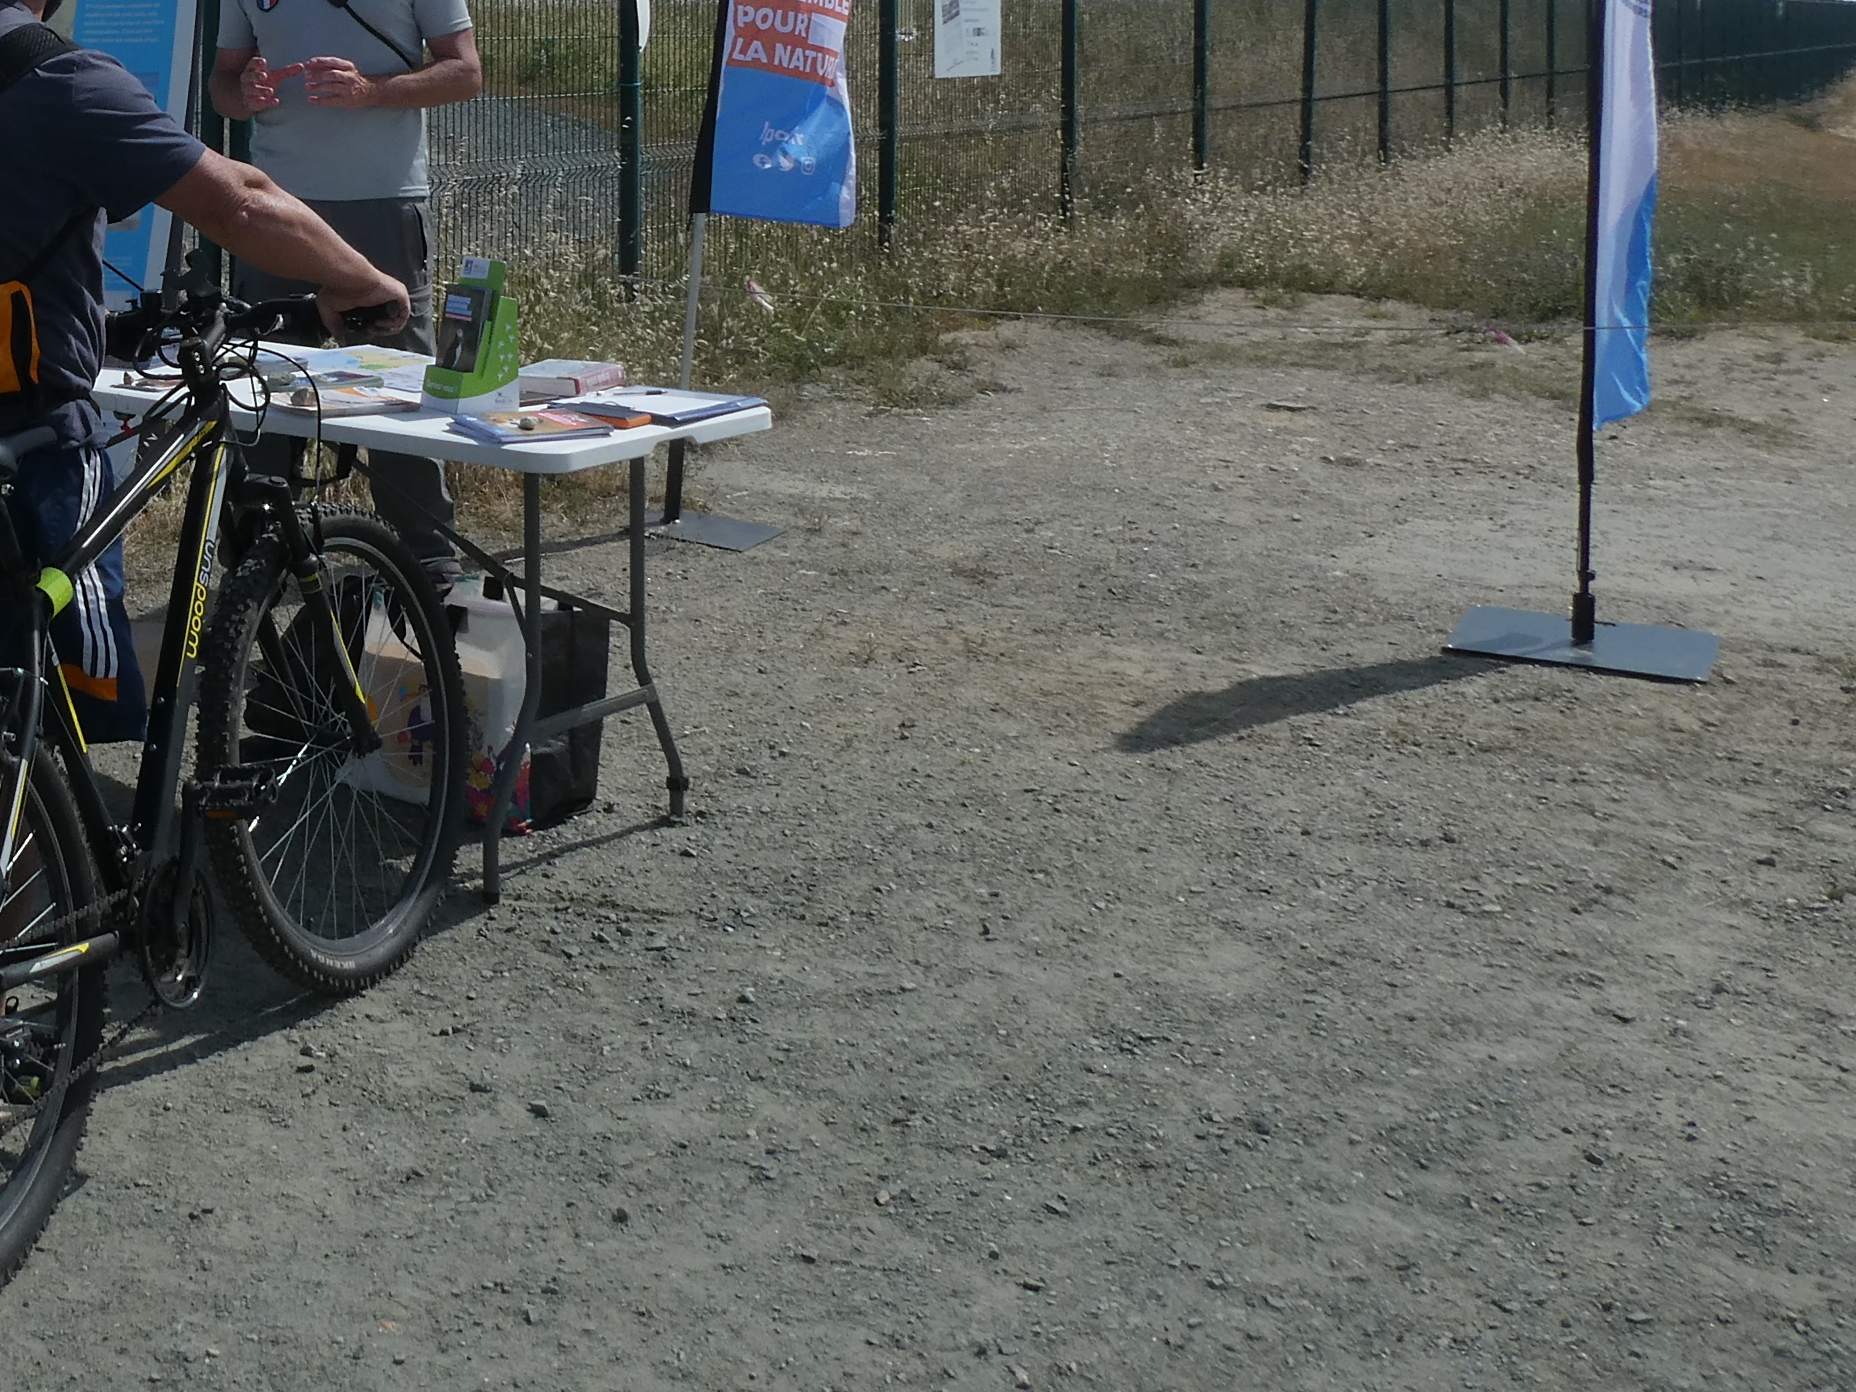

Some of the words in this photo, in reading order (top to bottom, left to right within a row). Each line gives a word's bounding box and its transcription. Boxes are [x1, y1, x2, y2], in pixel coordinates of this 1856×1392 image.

[736, 5, 809, 38] POUR
[732, 37, 768, 64] LA
[186, 541, 215, 659] woodsun
